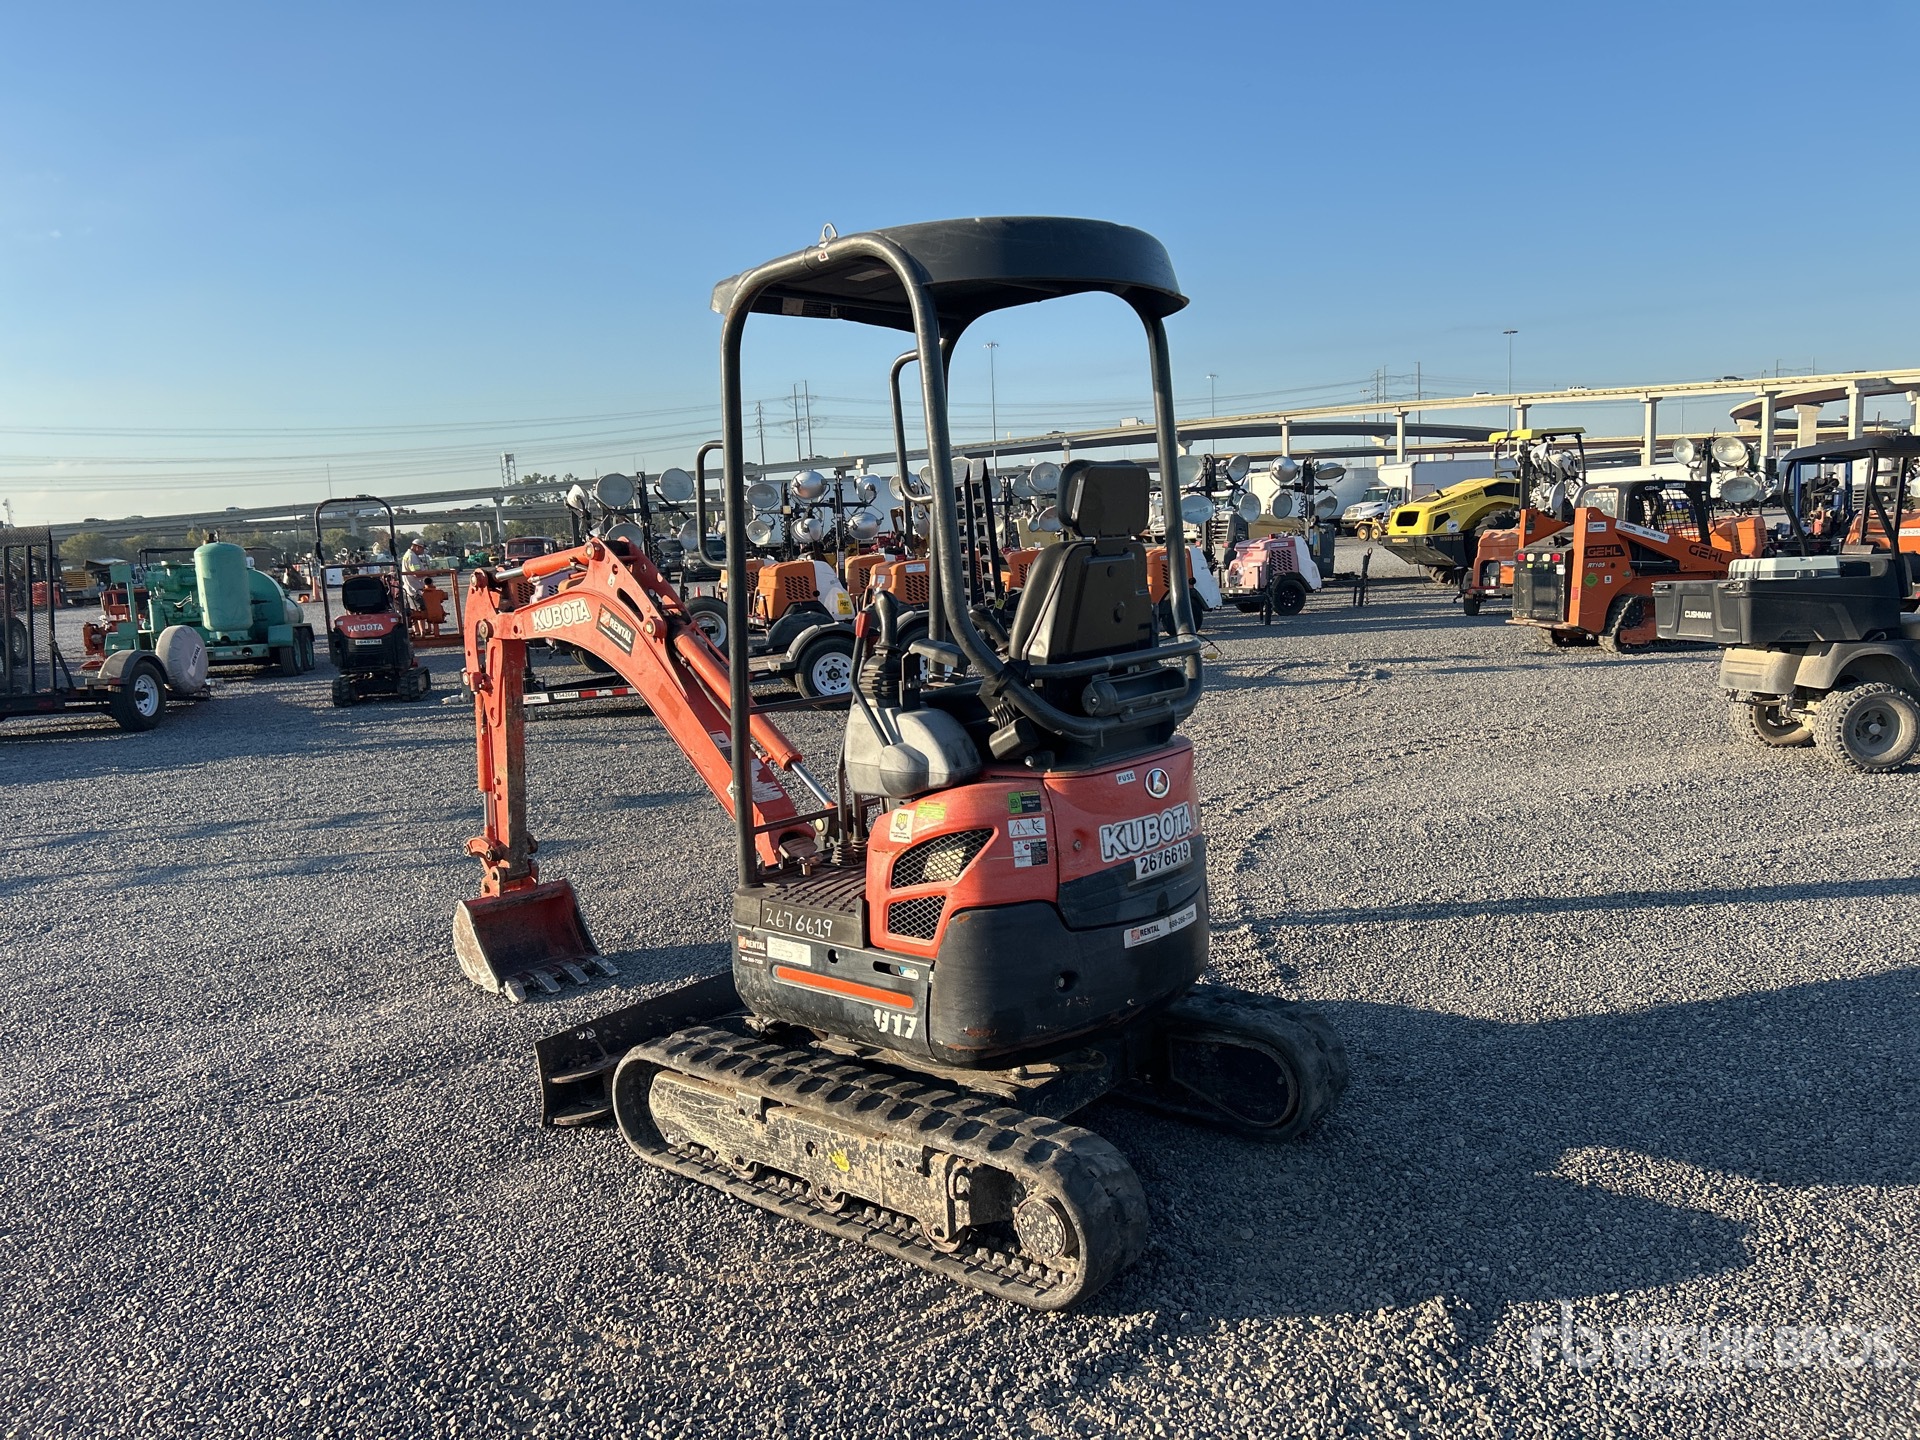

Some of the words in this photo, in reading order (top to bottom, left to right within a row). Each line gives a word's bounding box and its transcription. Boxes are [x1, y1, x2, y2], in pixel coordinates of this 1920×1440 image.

[1587, 546, 1621, 557] GEHL
[1688, 544, 1727, 565] GEHL
[531, 598, 592, 632] KUBOTA
[1684, 610, 1712, 619] CUSHMAN
[347, 623, 384, 633] KUBOTA
[609, 617, 632, 645] RENTAL
[1117, 773, 1135, 783] FUSE
[1101, 803, 1193, 860] KUBOTA
[1140, 842, 1189, 875] 2676619
[766, 908, 833, 938] 2676619
[1140, 925, 1160, 937] RENTAL
[745, 940, 767, 951] RENTAL
[873, 1008, 918, 1040] U17
